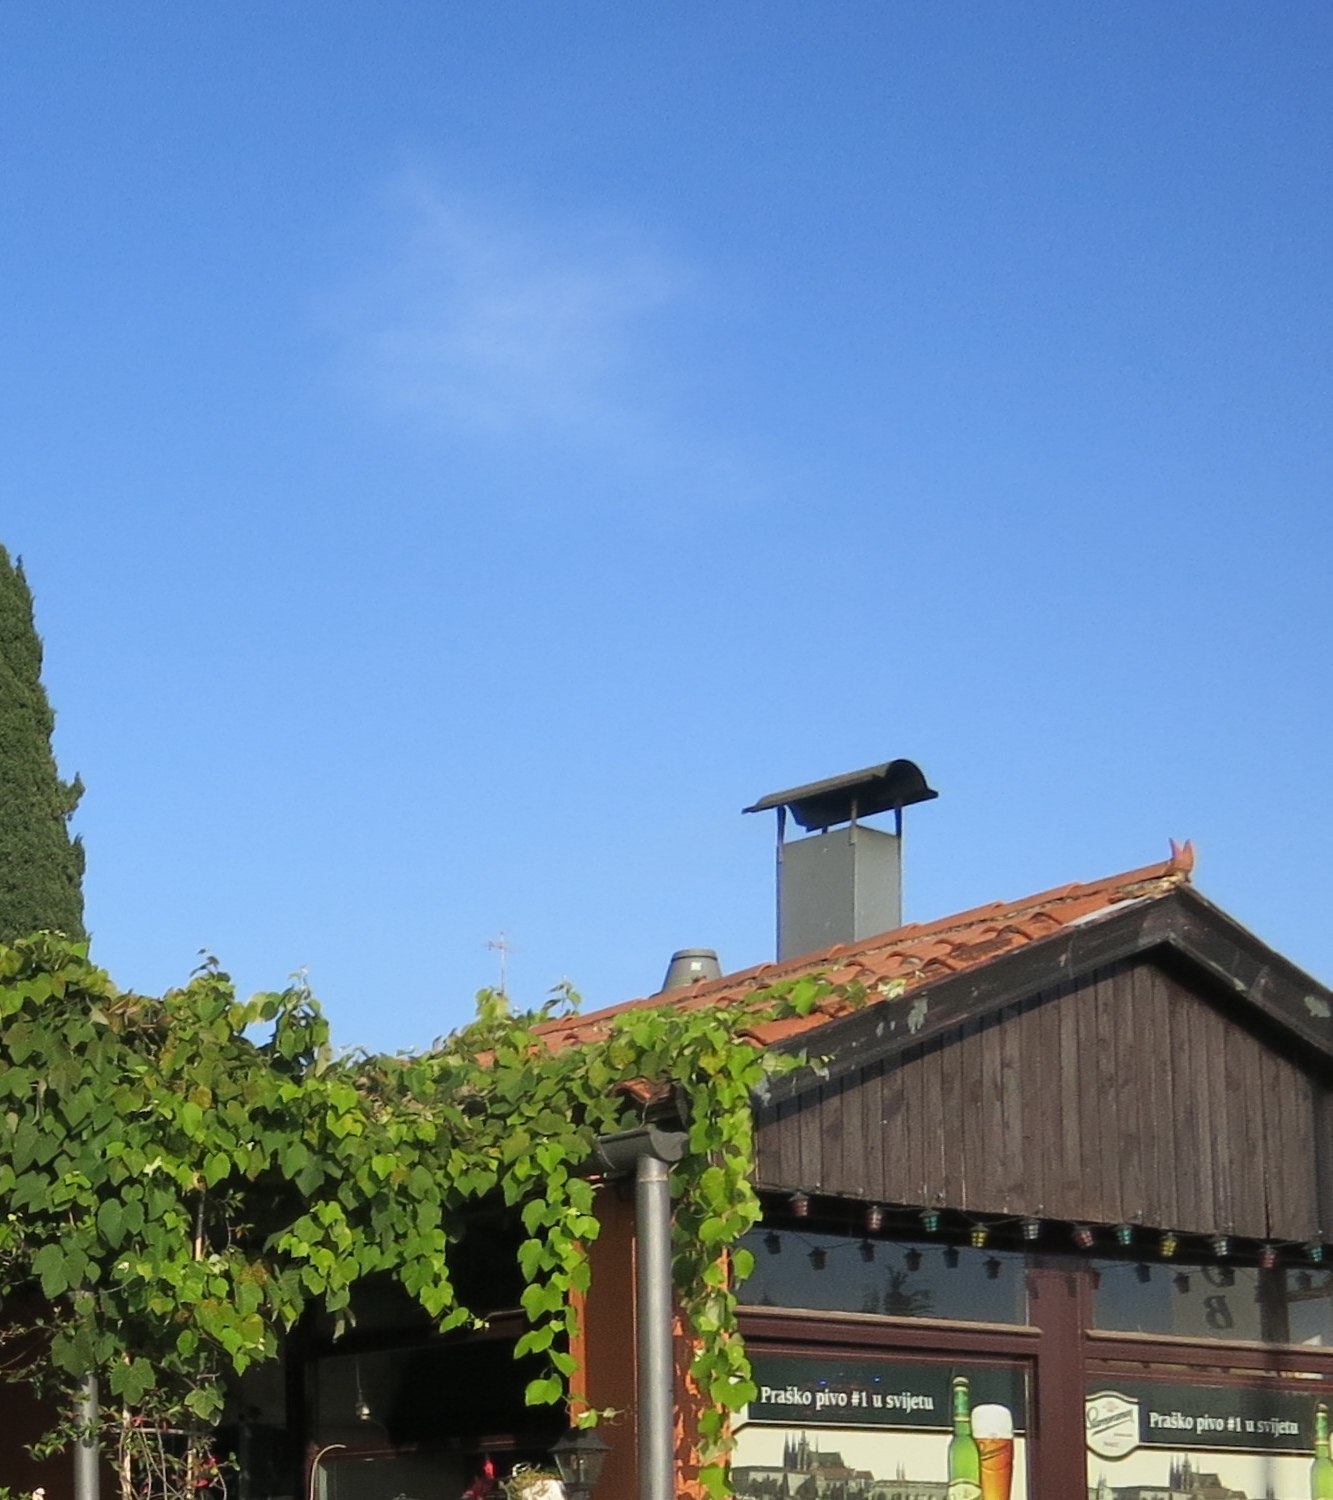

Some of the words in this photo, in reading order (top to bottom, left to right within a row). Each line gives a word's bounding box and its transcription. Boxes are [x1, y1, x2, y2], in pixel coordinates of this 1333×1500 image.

[760, 1386, 812, 1406] Praško
[815, 1389, 847, 1413] pivo
[851, 1391, 869, 1408] #1
[872, 1395, 883, 1408] u
[886, 1392, 934, 1414] svijetu
[1149, 1411, 1193, 1430] Praško
[1196, 1414, 1224, 1434] pivo
[1227, 1417, 1243, 1432] #1
[1245, 1420, 1255, 1432] u
[1257, 1417, 1299, 1438] svijetu
